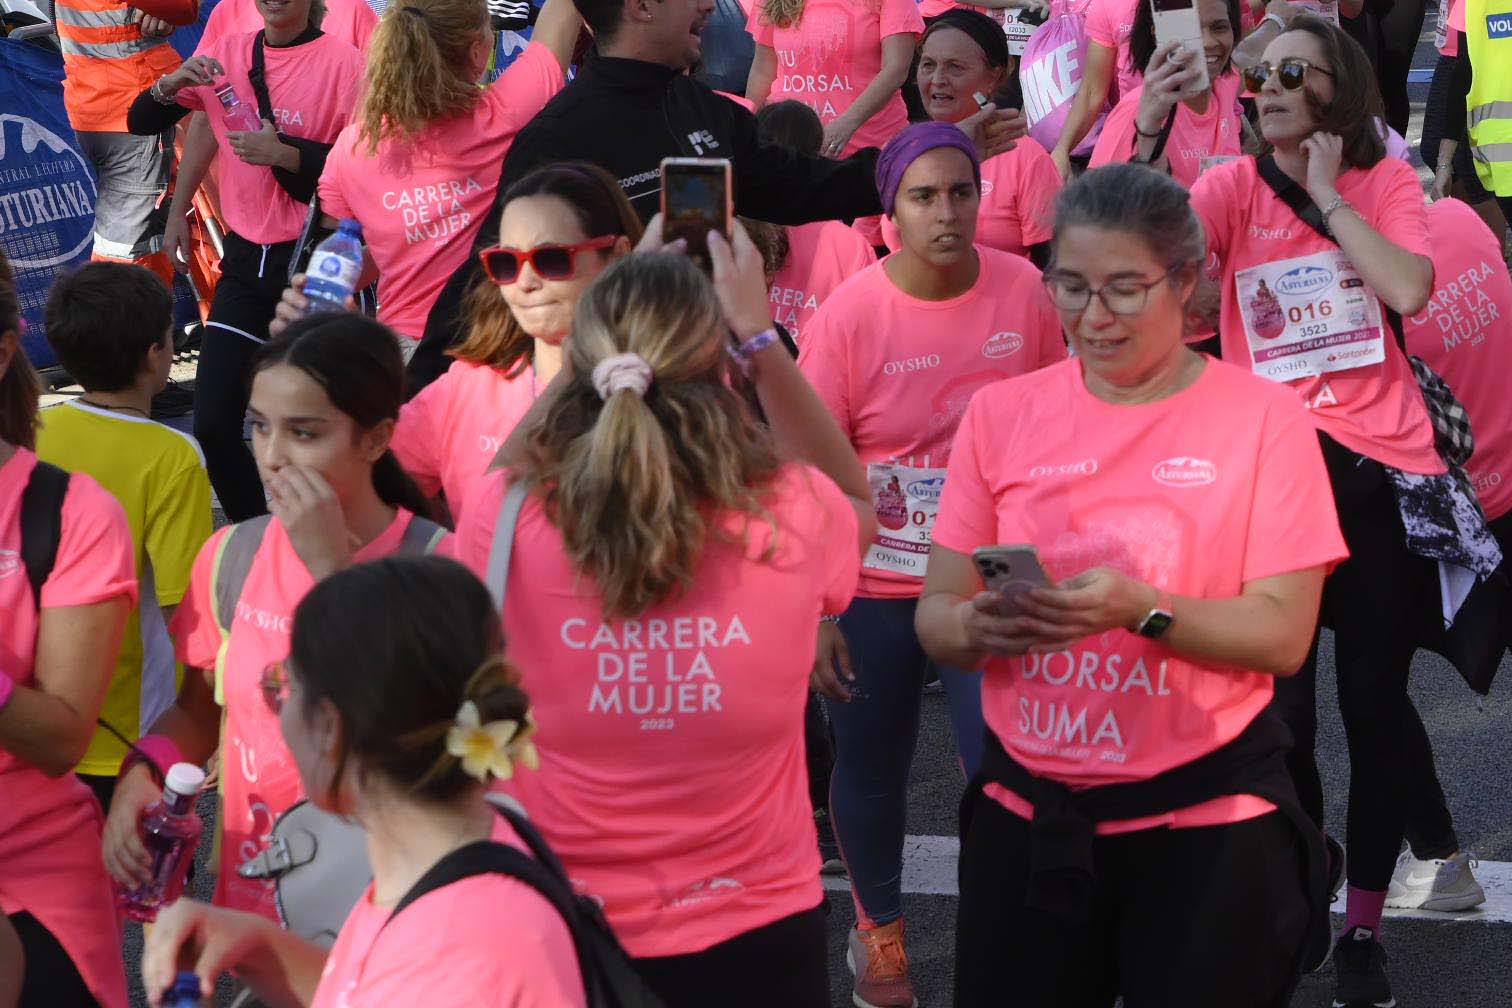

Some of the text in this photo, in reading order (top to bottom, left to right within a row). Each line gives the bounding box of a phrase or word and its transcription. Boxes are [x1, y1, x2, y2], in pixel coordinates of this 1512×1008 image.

[778, 50, 795, 67] TU
[783, 75, 853, 92] DORSAL
[382, 177, 482, 210] CARRERA
[403, 199, 465, 227] DE LA
[405, 213, 471, 245] MUJER
[1280, 275, 1330, 291] ASTURIANA
[1410, 260, 1495, 325] CARRERA
[1288, 299, 1333, 323] 016
[1436, 288, 1490, 333] DE LA
[1300, 323, 1328, 338] 3523
[1441, 302, 1500, 353] MUJER
[1267, 345, 1301, 358] CARRERA
[1302, 342, 1313, 351] DE
[1314, 339, 1324, 348] LA
[1326, 335, 1350, 345] MUJER
[1337, 348, 1376, 360] Santander
[884, 354, 940, 375] OYSHO
[1267, 359, 1308, 376] OYSHO
[1029, 458, 1098, 477] OYSHO
[881, 538, 930, 554] CARRERA DE
[876, 551, 916, 568] OYSHO
[560, 614, 752, 651] CARRERA
[598, 650, 716, 683] DE LA
[1021, 649, 1171, 695] DORSAL
[588, 683, 723, 715] MUJER
[641, 718, 675, 730] 2023
[1017, 696, 1125, 748] SUMA
